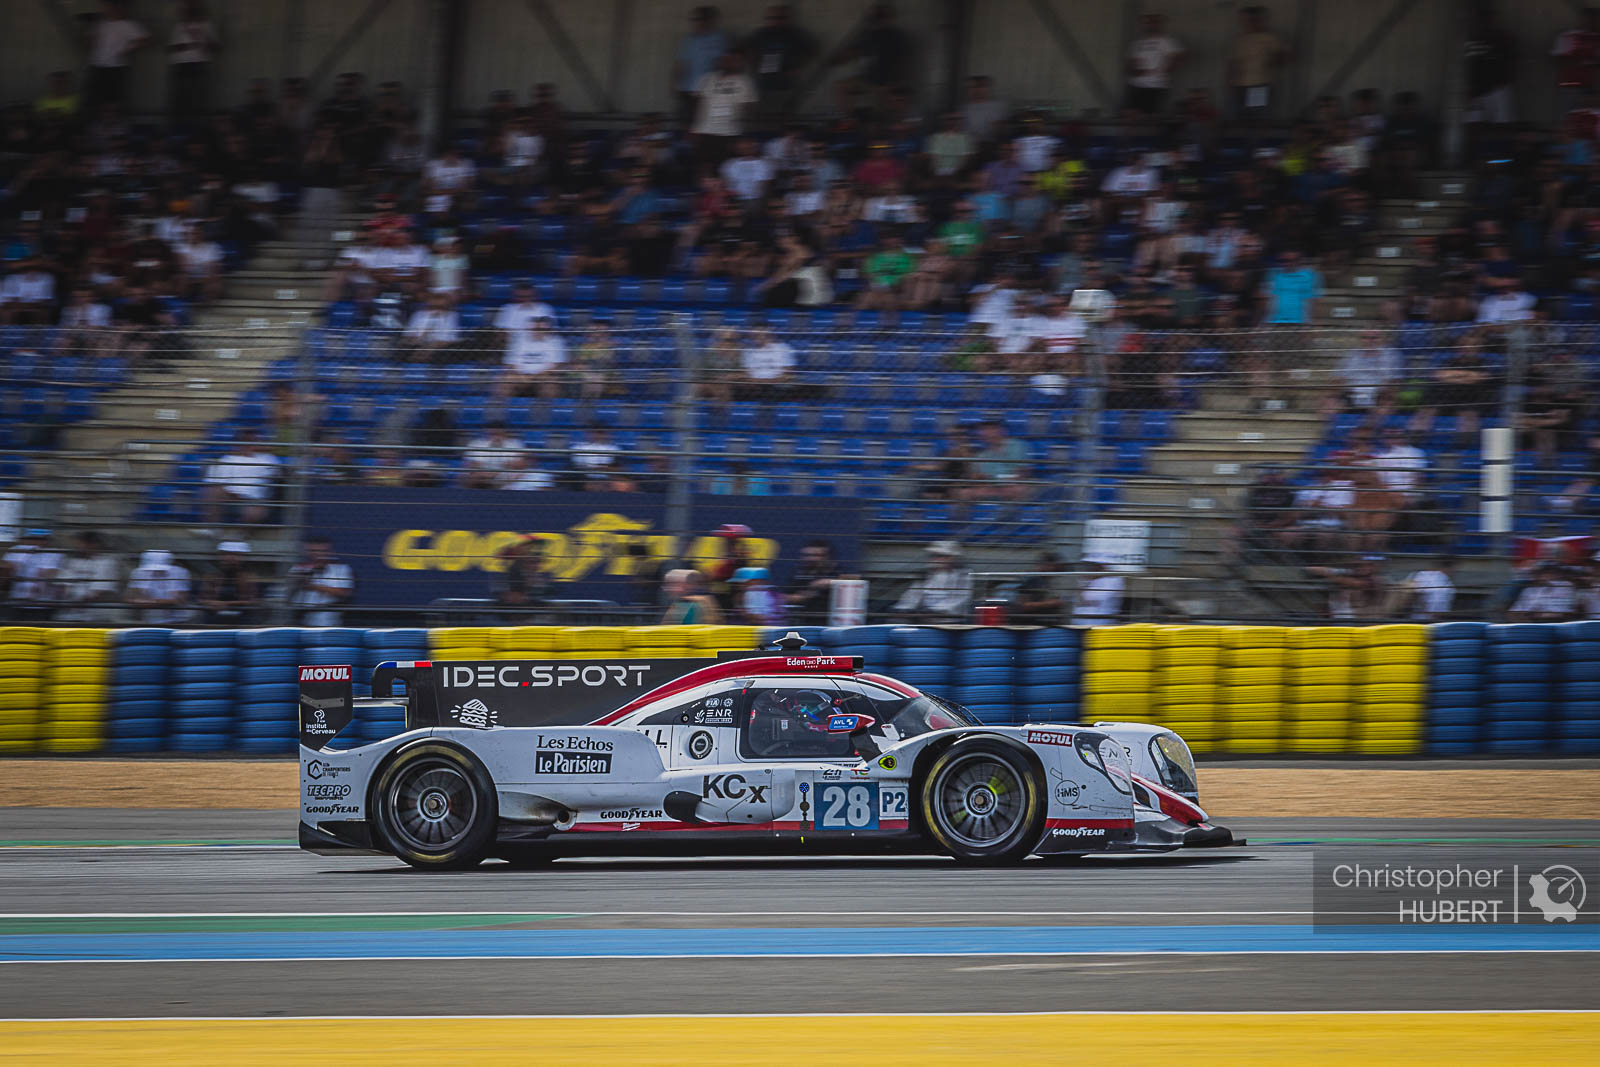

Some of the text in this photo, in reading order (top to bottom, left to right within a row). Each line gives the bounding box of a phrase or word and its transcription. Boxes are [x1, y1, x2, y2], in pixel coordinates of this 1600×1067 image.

[787, 656, 835, 665] Eden Park
[300, 667, 349, 680] MOTUL
[536, 735, 614, 751] Les Echos
[1029, 732, 1072, 745] MOTUL
[539, 753, 607, 773] Le Parisien
[307, 784, 352, 797] TECPRO
[306, 803, 359, 815] GOODYEAR
[823, 785, 906, 827] 28 P2
[600, 808, 663, 820] GOODYEAR
[1052, 827, 1105, 838] GOODYEAR
